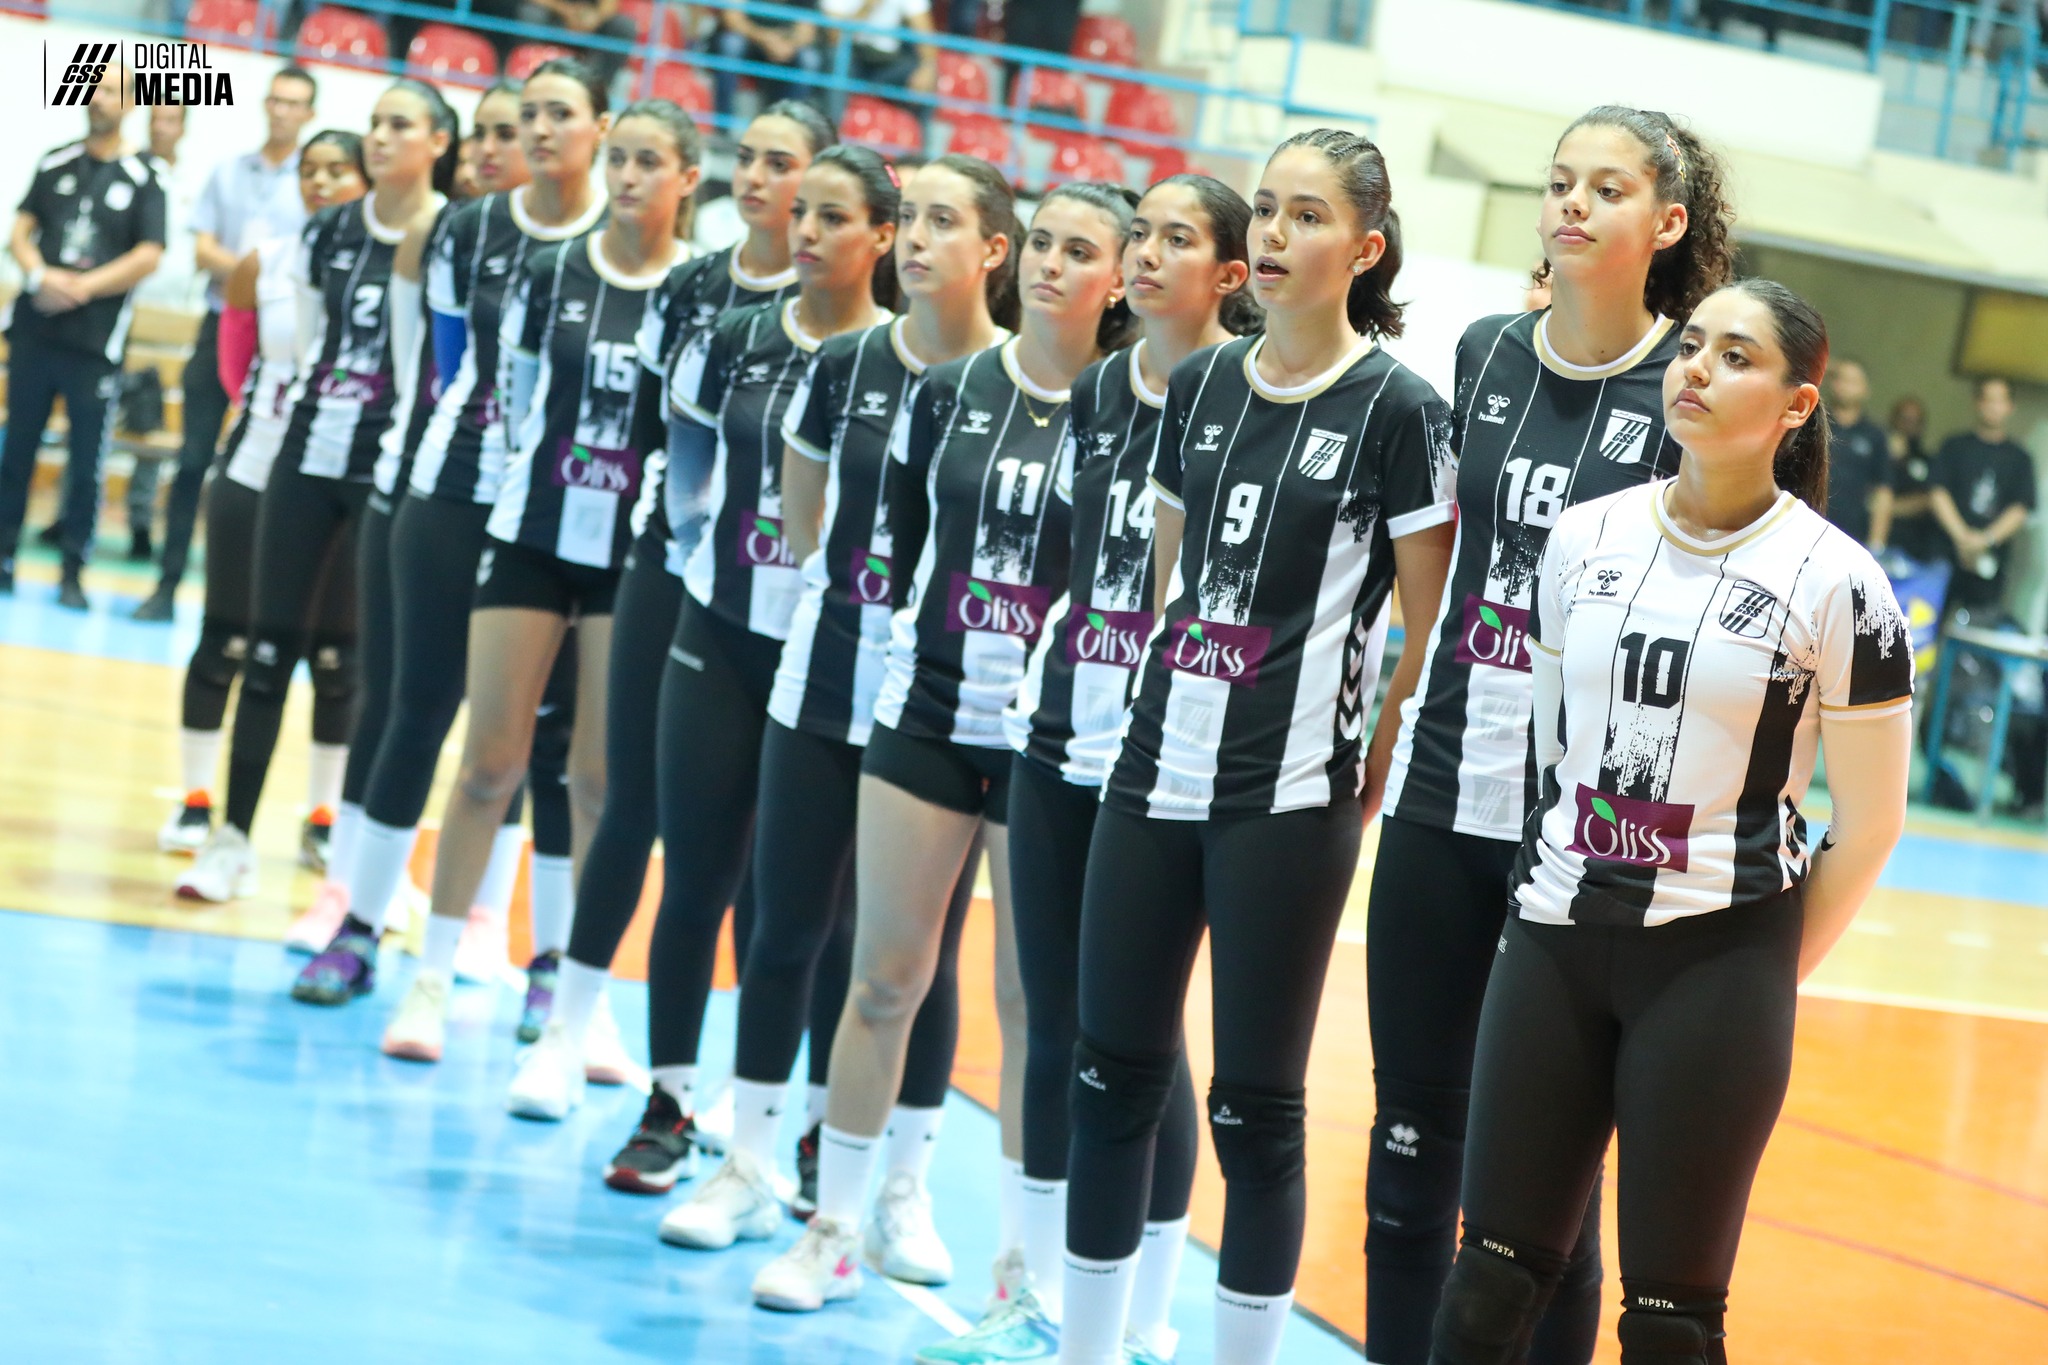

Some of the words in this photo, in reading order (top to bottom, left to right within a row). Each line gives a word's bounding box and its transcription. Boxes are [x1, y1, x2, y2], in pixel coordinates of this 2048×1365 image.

[352, 284, 383, 327] 2
[590, 340, 637, 392] 15
[1310, 450, 1334, 462] CSS
[1611, 431, 1638, 445] CSS
[997, 458, 1045, 516] 11
[1110, 479, 1156, 539] 14
[1505, 457, 1571, 530] 18
[1221, 482, 1262, 545] 9
[746, 519, 795, 564] Oli
[1733, 603, 1763, 618] CSS
[1467, 605, 1533, 667] Olis
[1620, 631, 1691, 710] 10
[1385, 1140, 1418, 1158] errea
[1482, 1238, 1516, 1259] KIPSTA
[1637, 1296, 1675, 1310] KIPSTA
